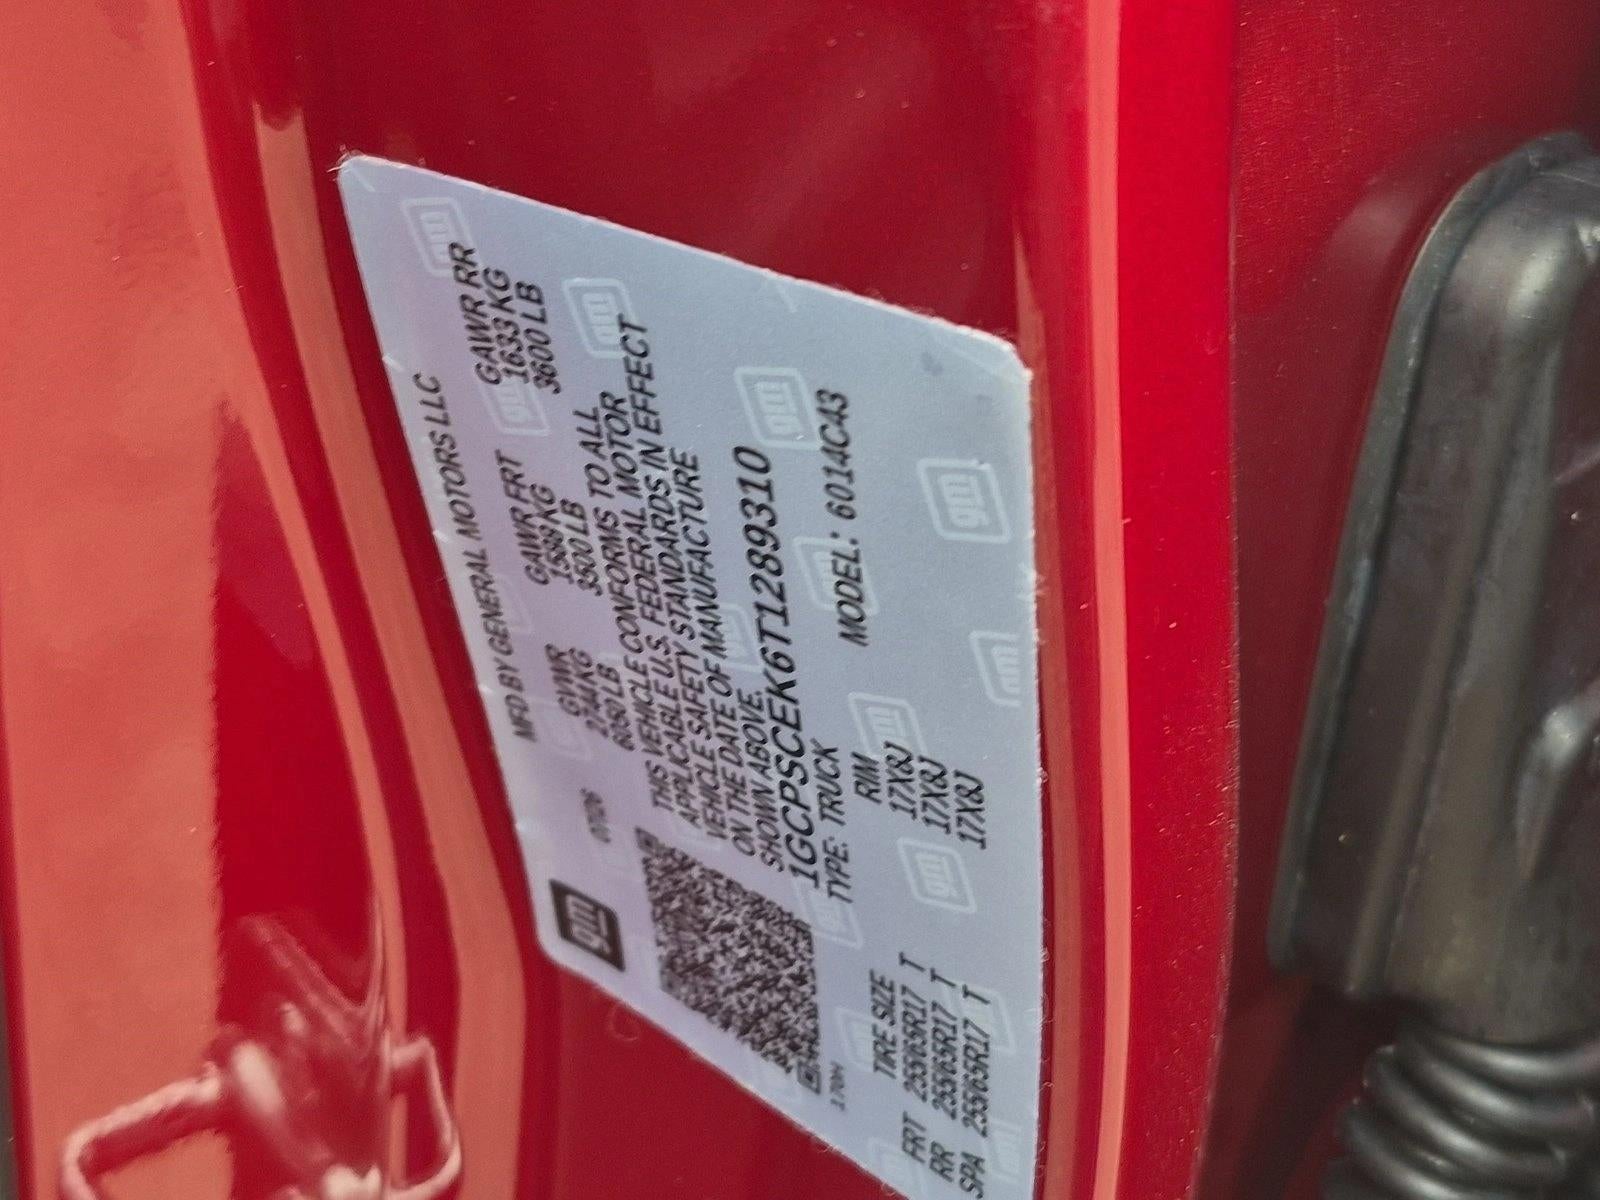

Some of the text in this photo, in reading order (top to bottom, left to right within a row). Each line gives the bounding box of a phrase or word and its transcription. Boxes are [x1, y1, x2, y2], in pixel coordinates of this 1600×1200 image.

[448, 242, 483, 289] RR
[482, 267, 516, 315] KG
[514, 281, 548, 325] LB
[459, 294, 502, 385] GAWR
[491, 317, 530, 384] 1633
[523, 328, 561, 395] 3600
[494, 449, 532, 505] FRT
[815, 389, 857, 520] 6014C43
[509, 506, 550, 586] GAWR
[529, 483, 561, 525] KG
[559, 498, 590, 537] LB
[412, 372, 536, 742] MFD BY GENERAL MOTORS LLC
[568, 537, 603, 597] 3500
[617, 313, 728, 840] VEHICLE SAFETY STANDARDS IN EFFECT
[830, 532, 868, 647] MODEL:
[572, 407, 675, 812] THIS VEHICLE CONFORMS TO ALL
[599, 391, 700, 828] APPLICABLE U.S. FEDERAL MOTOR
[669, 448, 756, 857] ON THE DATE OF MANUFACTURE
[544, 643, 582, 717] GVWR
[567, 647, 598, 686] KG
[595, 662, 625, 699] LB
[734, 447, 819, 888] 1GCPSCEK6T1289310
[736, 689, 785, 872] SHOWN ABOVE.
[811, 738, 845, 826] TRUCK
[822, 836, 853, 904] TYPE:
[851, 751, 898, 1079] TIRE SIZE RIM
[884, 741, 928, 1164] FRT 255/65R17 T 17X8J
[917, 755, 958, 1183] RR 255/65R17 T 17X8J
[953, 769, 991, 1199] SPA 255/65R17 T 17X8J
